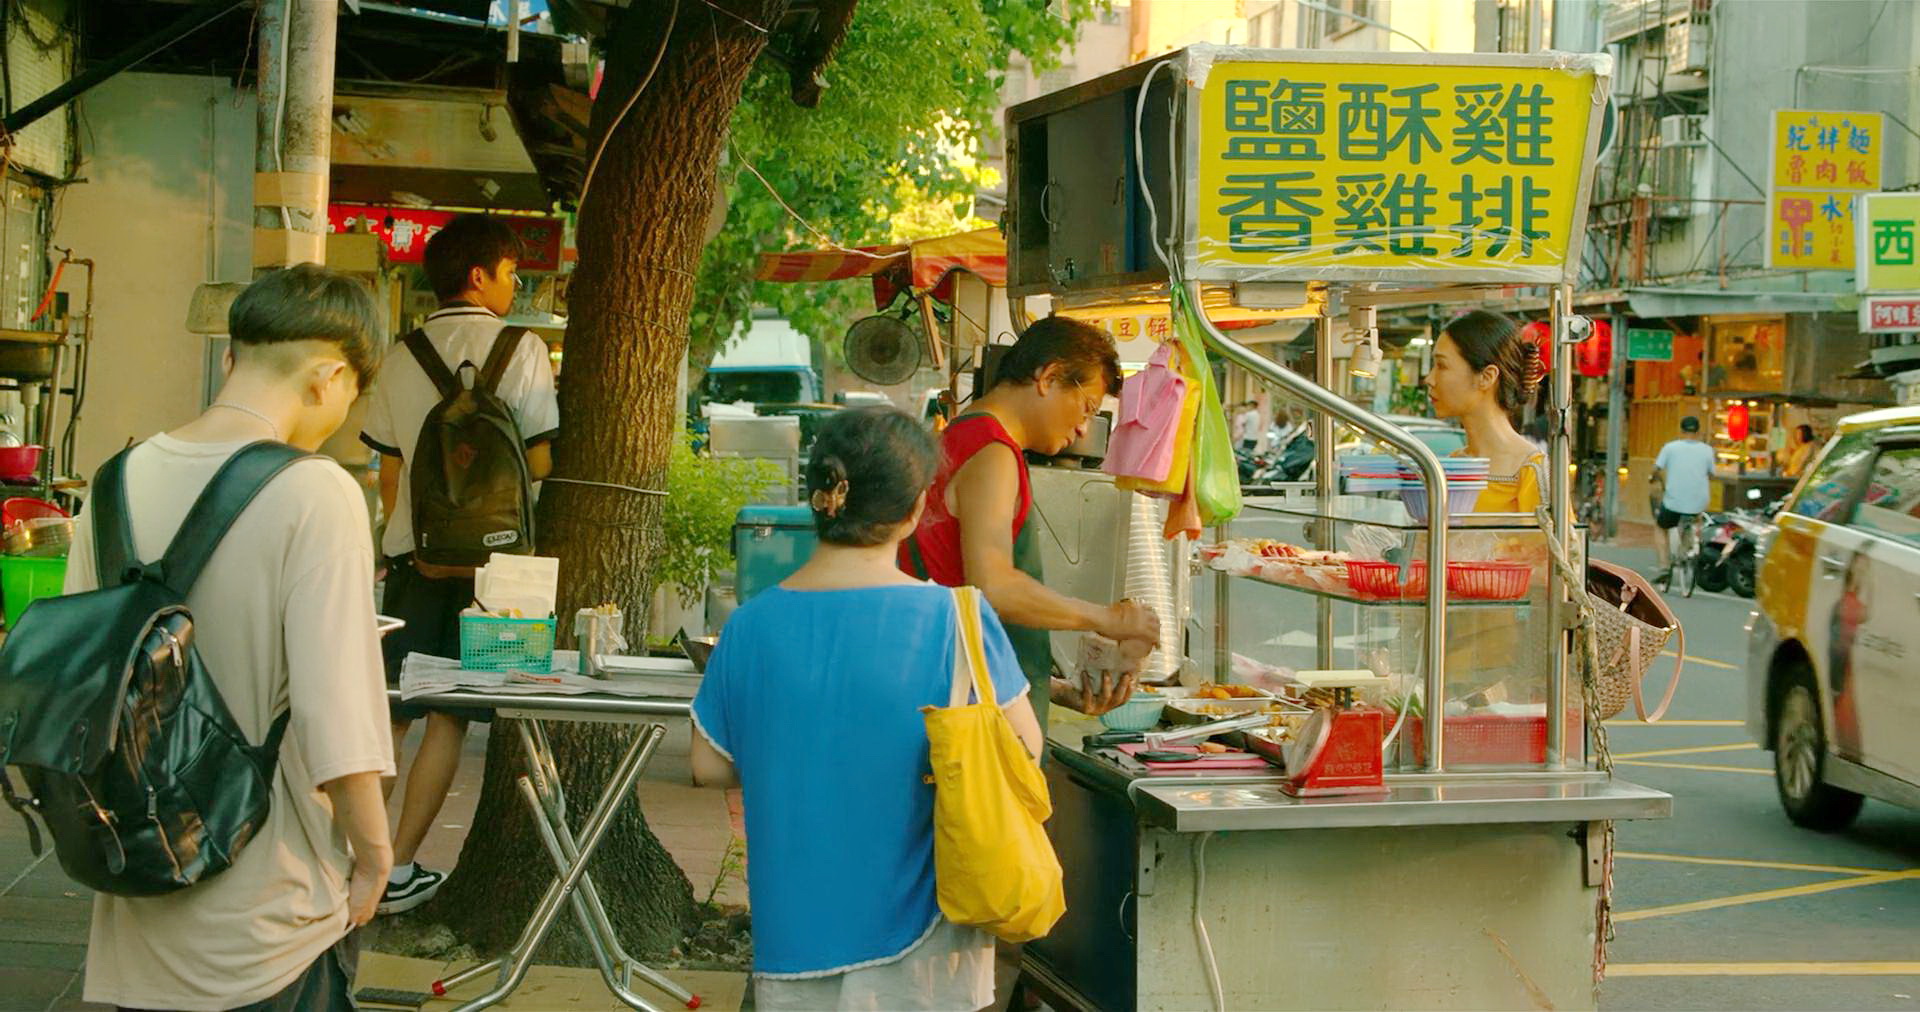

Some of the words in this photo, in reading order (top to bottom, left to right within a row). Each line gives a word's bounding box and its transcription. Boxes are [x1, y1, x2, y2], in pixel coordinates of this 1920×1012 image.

[1221, 78, 1554, 166] 鹽酥雞
[1785, 124, 1871, 154] 乾拌麵
[1786, 154, 1872, 185] 魯肉飯
[1217, 171, 1551, 258] 香雞排
[1820, 194, 1853, 222] 水
[1872, 220, 1915, 265] 西
